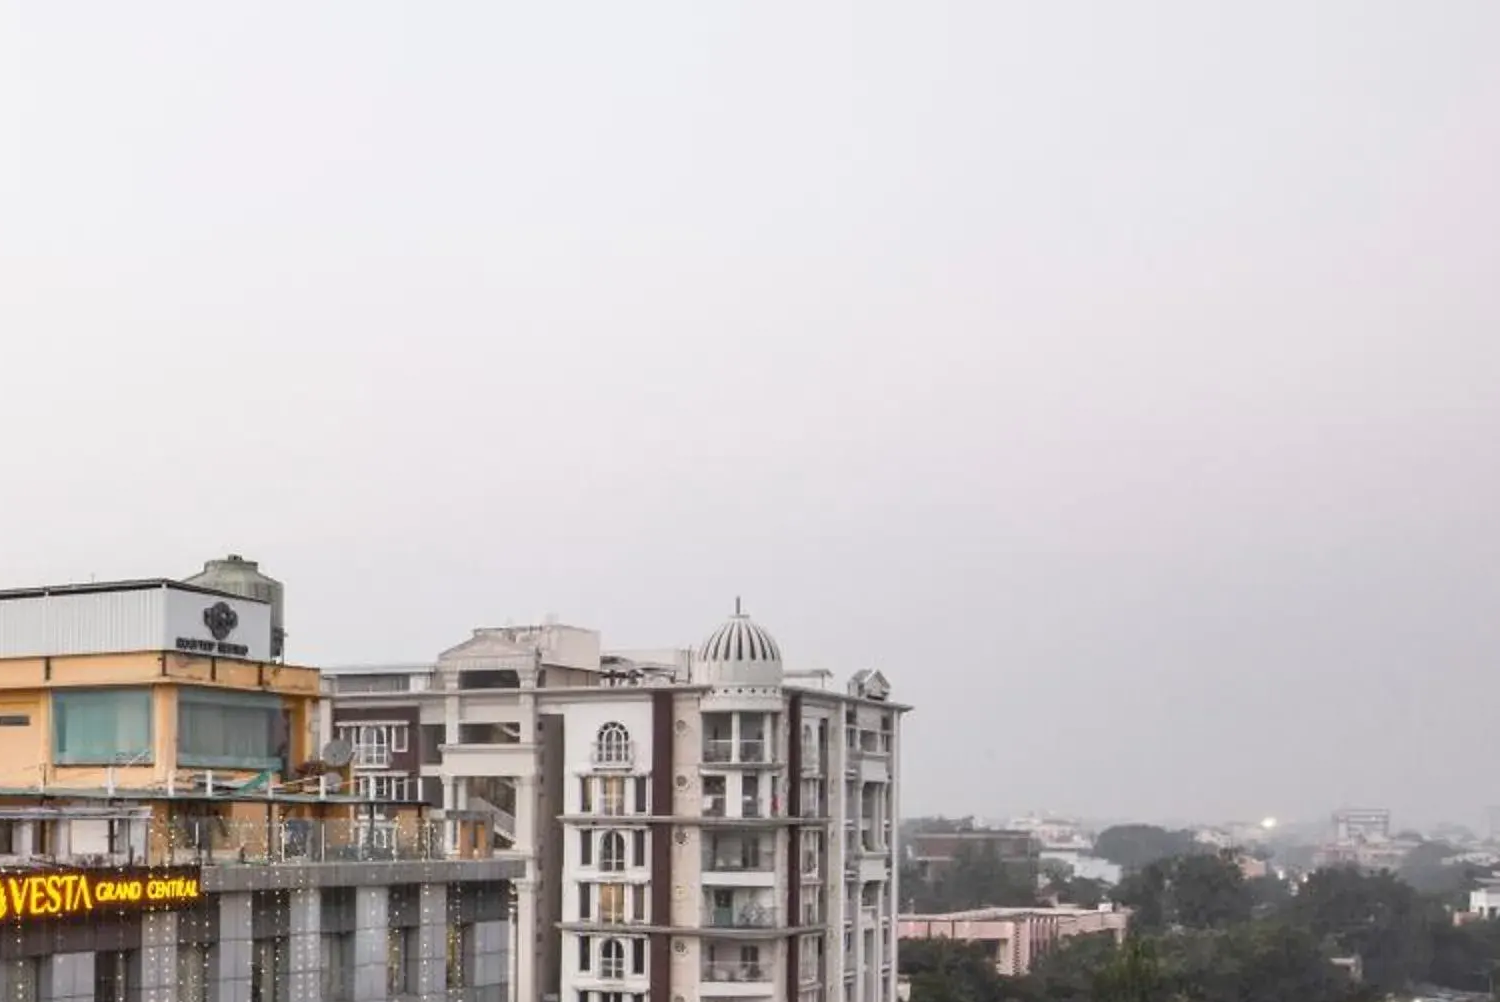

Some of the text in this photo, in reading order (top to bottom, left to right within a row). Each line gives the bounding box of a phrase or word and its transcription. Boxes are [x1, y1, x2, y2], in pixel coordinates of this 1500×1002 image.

[9, 876, 199, 914] VESTA GRAND CENTRAL
